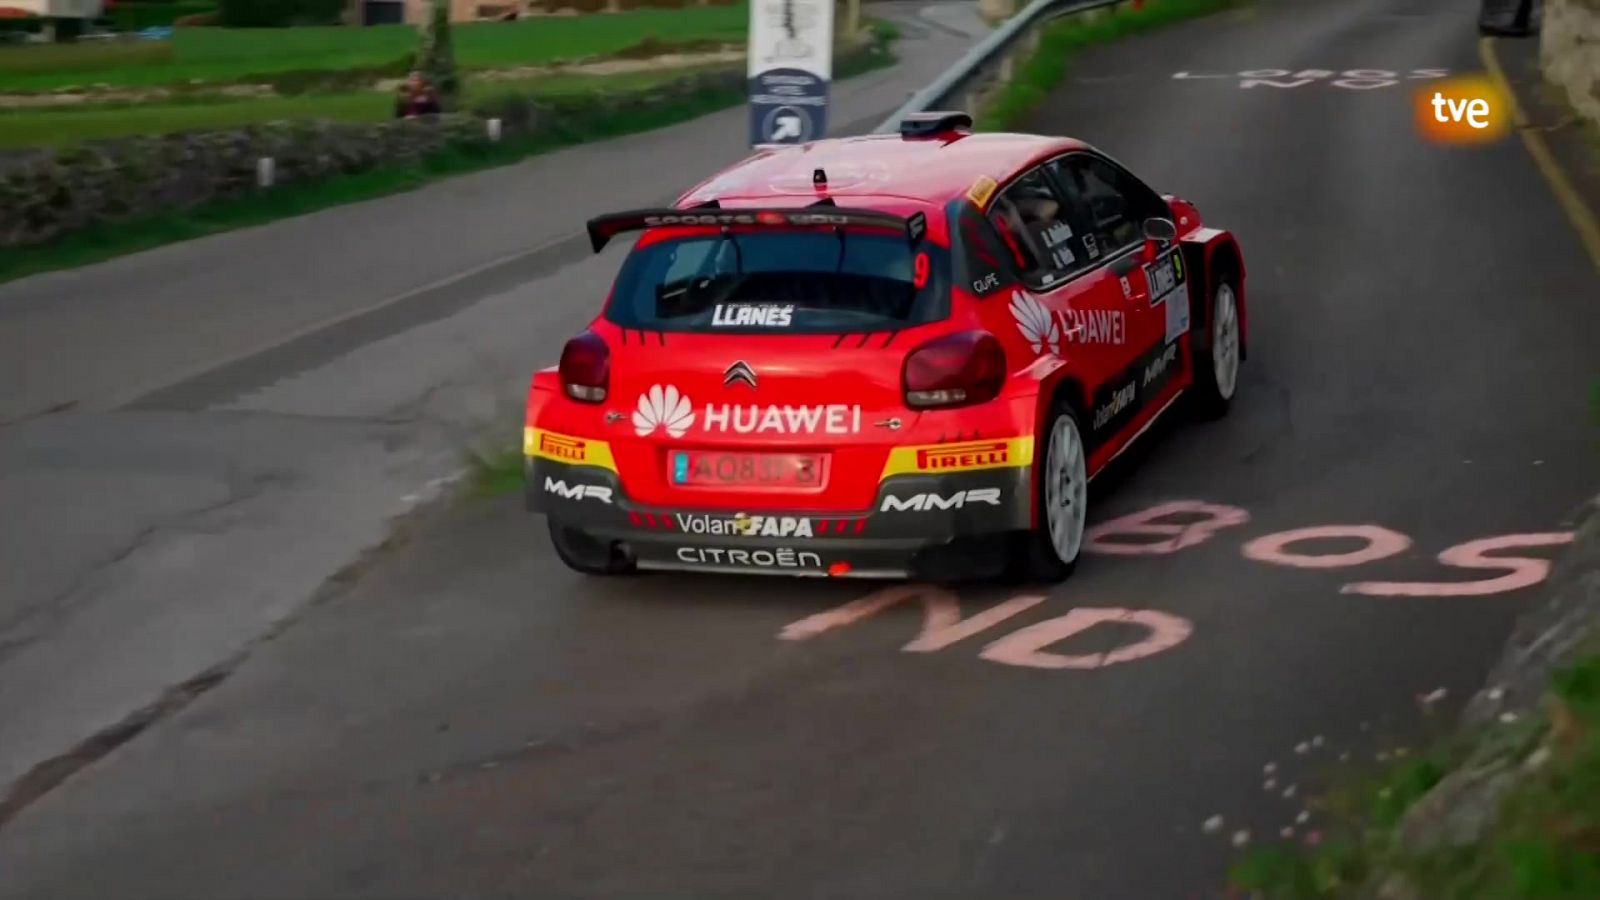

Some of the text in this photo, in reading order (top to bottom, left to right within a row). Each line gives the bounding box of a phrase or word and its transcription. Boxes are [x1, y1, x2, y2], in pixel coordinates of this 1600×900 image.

[913, 252, 930, 290] 9
[711, 303, 794, 327] LLANES
[703, 403, 861, 435] HUAWEI
[916, 442, 1009, 470] PIRELLI
[544, 476, 613, 504] MMR
[880, 487, 1001, 512] MMR
[676, 546, 823, 568] CITROËN
